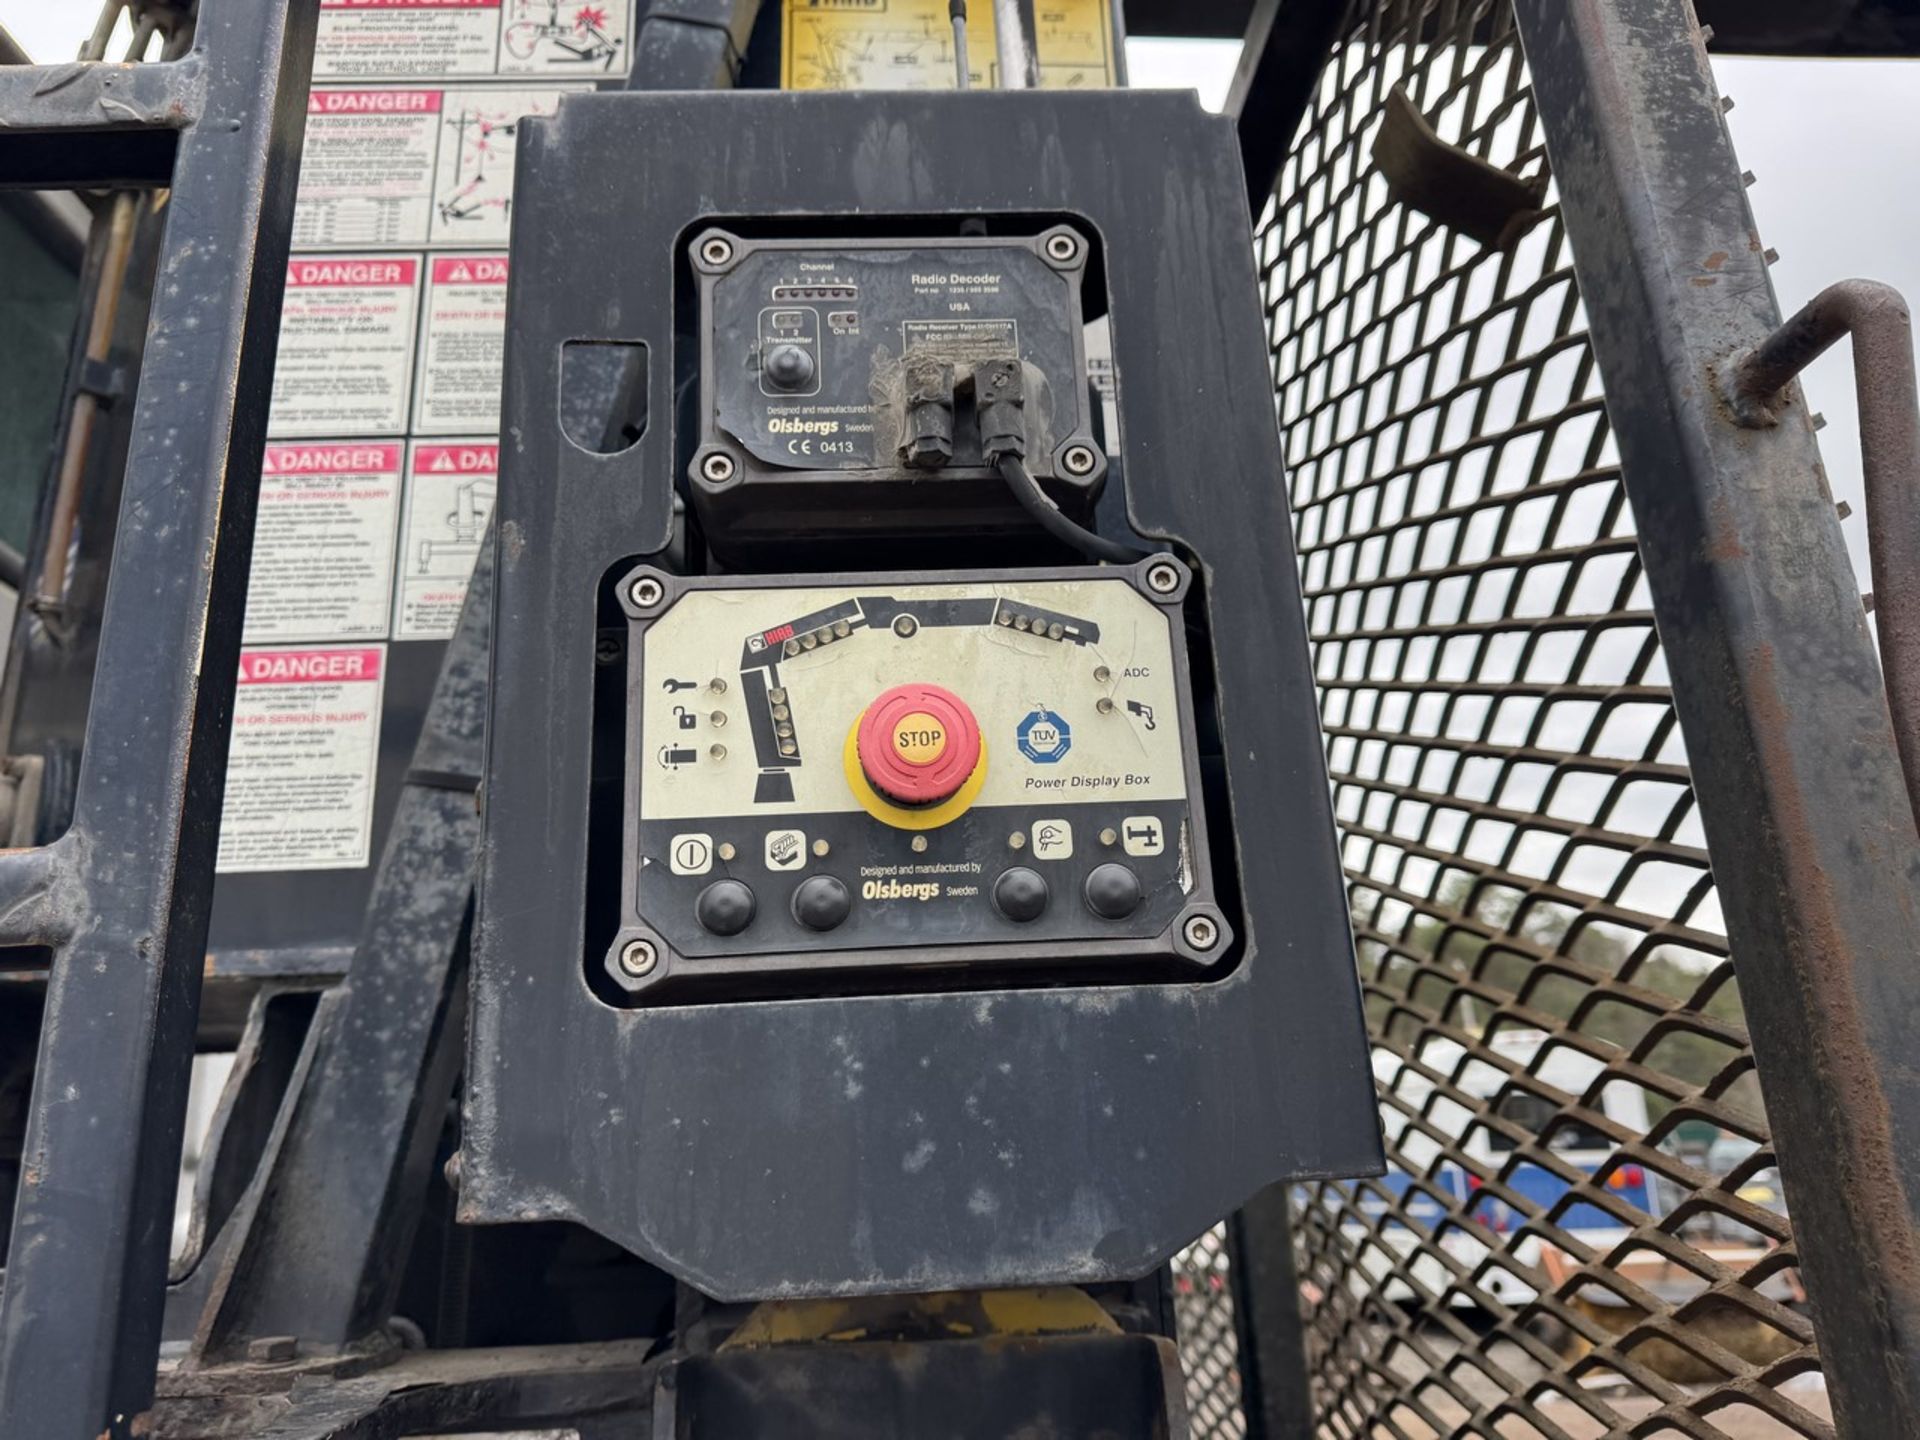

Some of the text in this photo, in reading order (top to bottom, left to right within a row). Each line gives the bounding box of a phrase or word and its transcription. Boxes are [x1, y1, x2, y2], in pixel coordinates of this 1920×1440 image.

[326, 93, 427, 110] DANGER
[301, 264, 401, 282] DANGER
[800, 263, 835, 271] Channel
[793, 277, 798, 285] 2
[807, 276, 812, 284] 3
[820, 276, 826, 284] 4
[911, 273, 1001, 285] Radio Decoder
[949, 303, 970, 311] USA
[767, 406, 799, 416] Designed
[802, 406, 815, 414] and
[817, 405, 867, 414] manufactured
[768, 417, 874, 435] Olsbergs Sweden
[820, 442, 854, 453] 0413
[280, 451, 385, 470] DANGER
[765, 624, 794, 645] HIAB
[253, 656, 364, 679] DANGER
[1123, 668, 1150, 677] ADC
[268, 714, 322, 724] SERIOUS
[326, 713, 368, 722] INJURY
[899, 730, 941, 748] STOP
[1025, 774, 1151, 789] Power Display Box
[861, 862, 981, 877] Designed and manufactured by
[862, 879, 978, 900] Olsbergs Sweden
